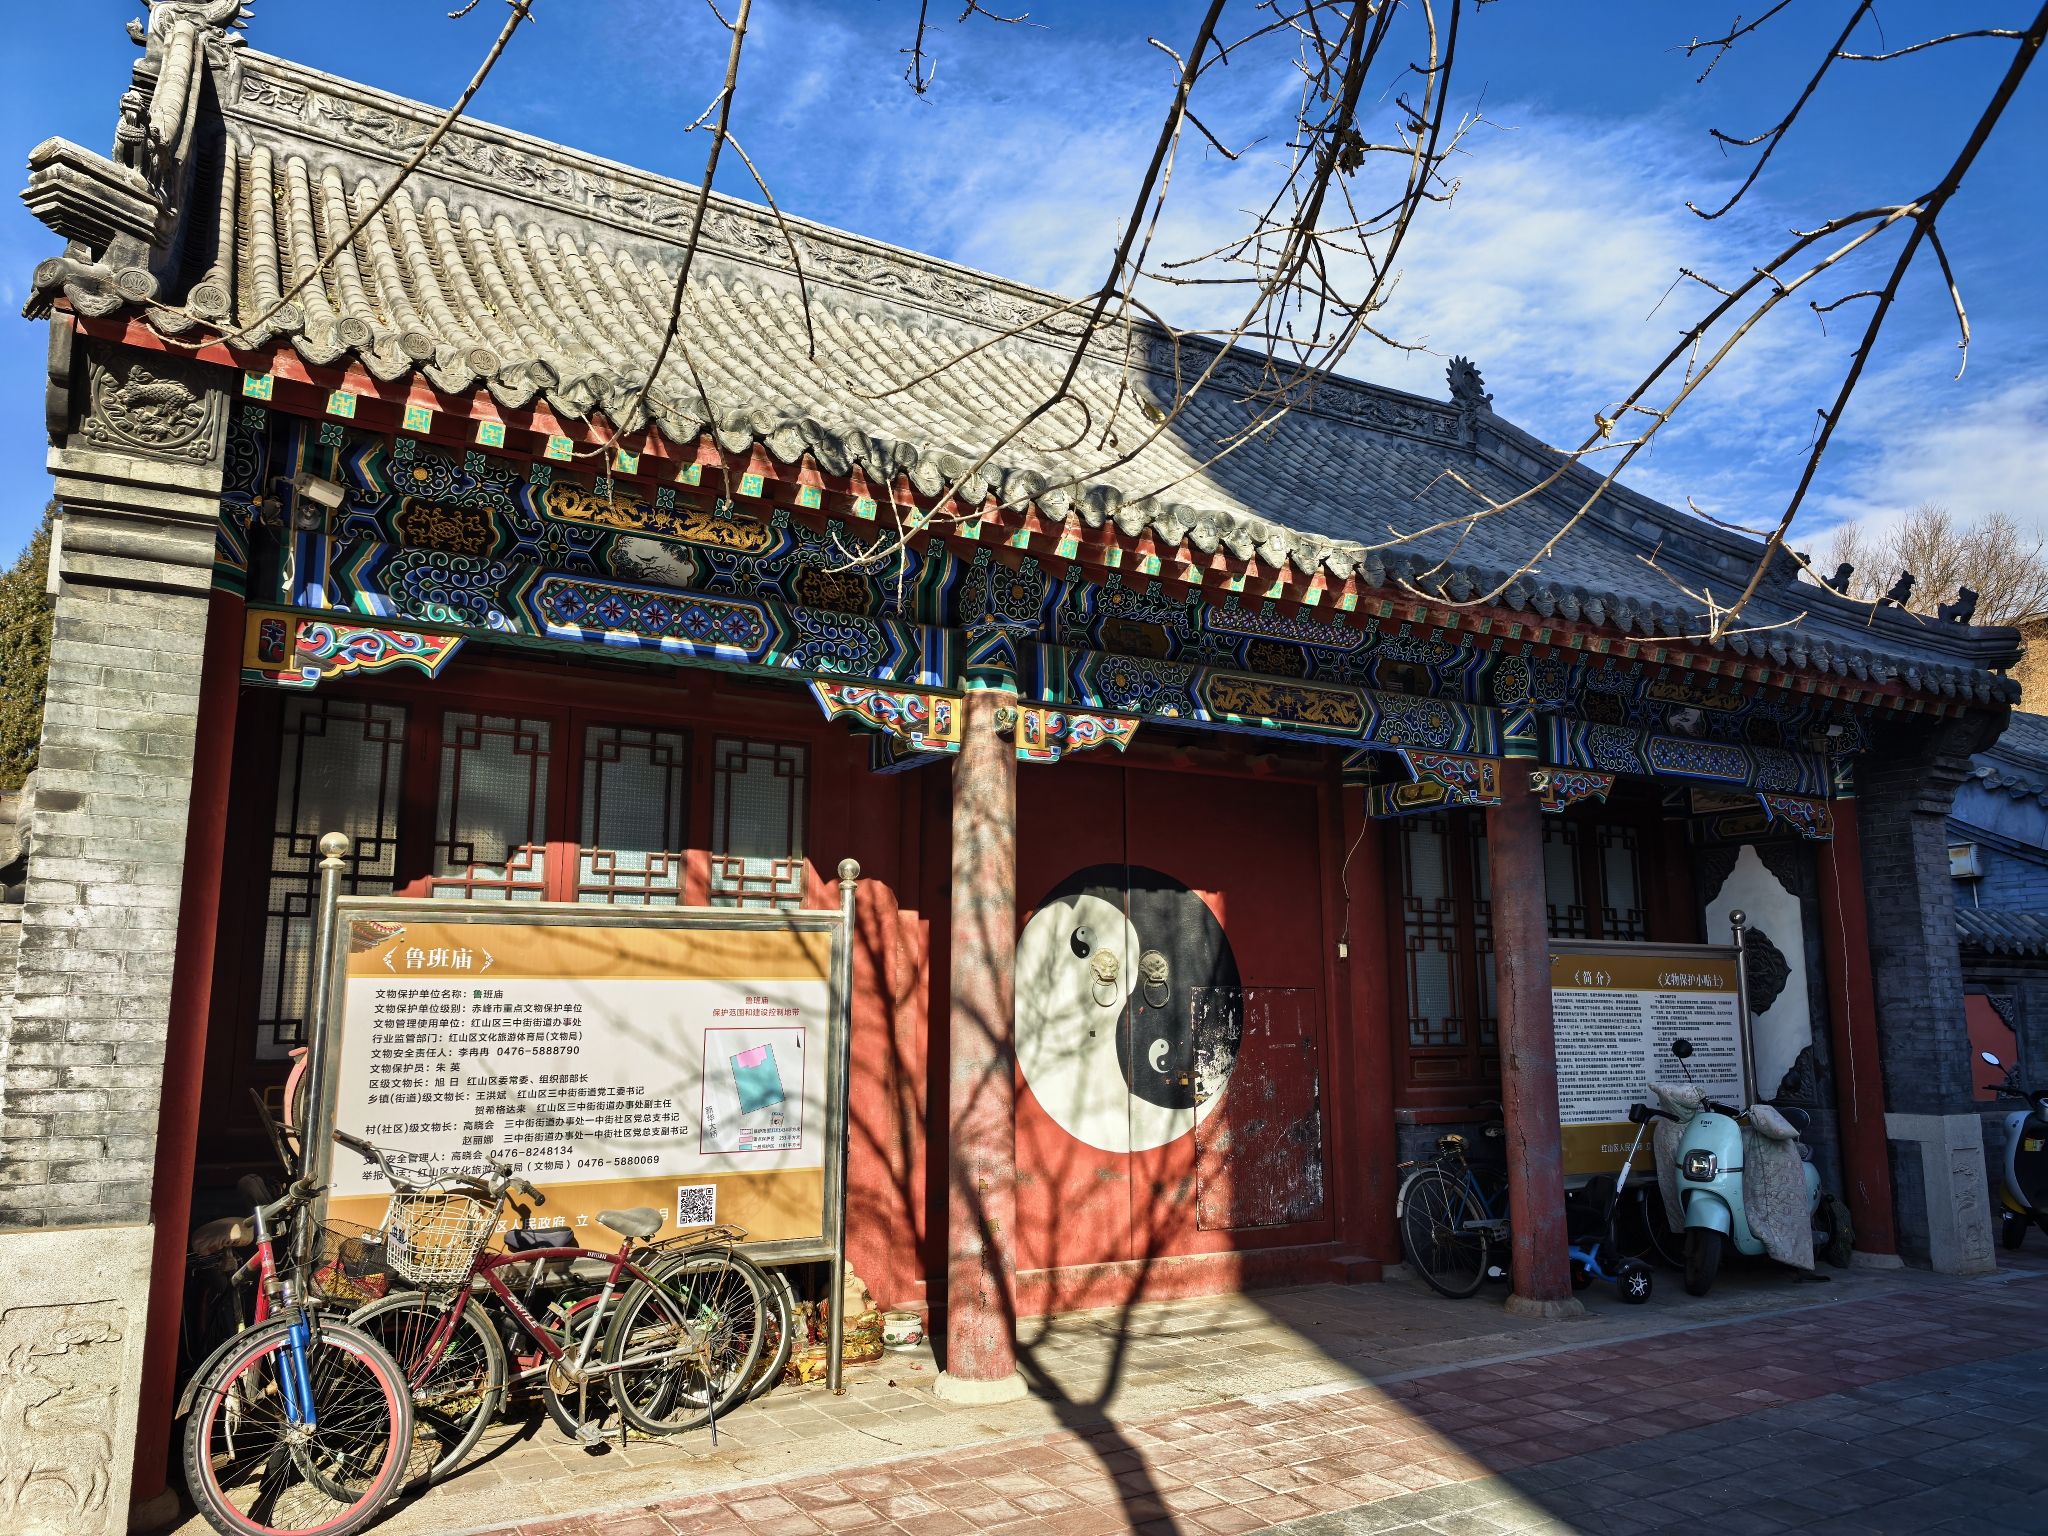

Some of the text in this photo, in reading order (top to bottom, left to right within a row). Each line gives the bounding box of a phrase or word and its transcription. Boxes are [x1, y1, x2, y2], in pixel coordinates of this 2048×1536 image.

[403, 947, 474, 970] 鲁班庙
[496, 1045, 580, 1057] 0476-5888790
[363, 1145, 574, 1166] 文安全管理人：高晓会 0476-8248134
